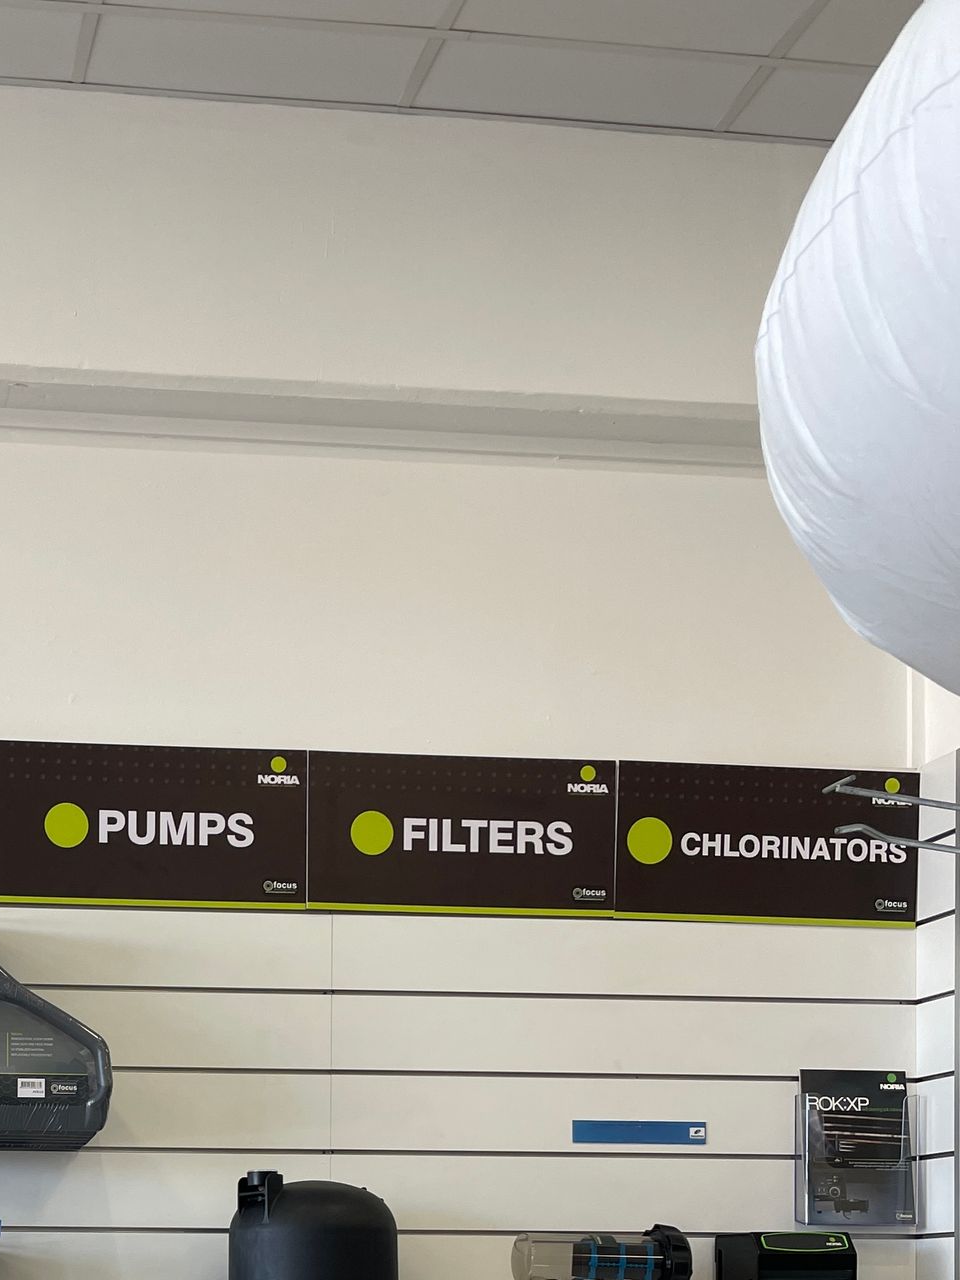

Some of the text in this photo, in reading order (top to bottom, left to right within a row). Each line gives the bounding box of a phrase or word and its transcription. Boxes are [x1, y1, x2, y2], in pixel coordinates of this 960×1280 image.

[257, 774, 300, 785] NORIA
[567, 783, 609, 794] NORIA
[98, 809, 255, 848] PUMPS
[403, 817, 574, 856] FILTERS
[680, 831, 907, 864] CHLORINATORS
[273, 881, 297, 890] focus
[582, 887, 606, 897] focus
[884, 899, 908, 909] focus
